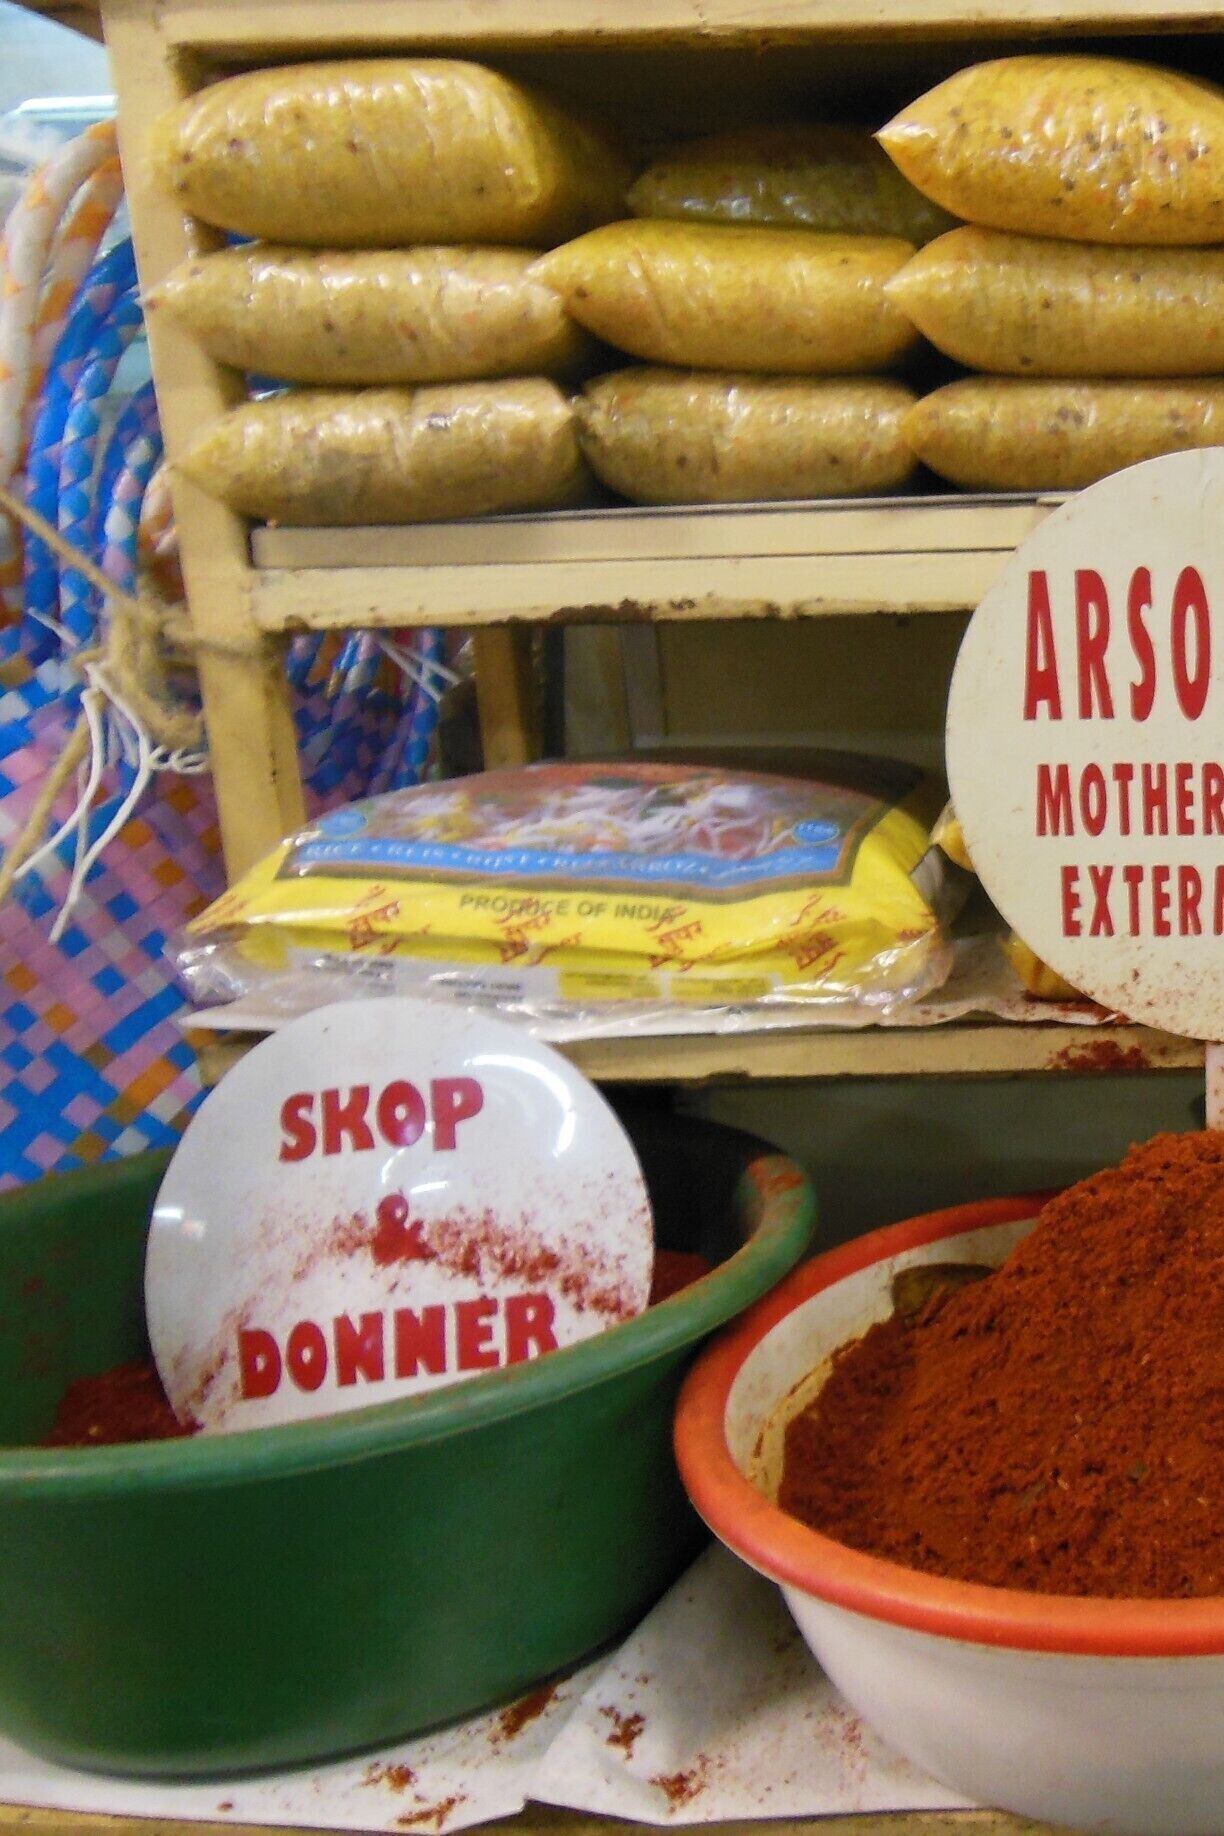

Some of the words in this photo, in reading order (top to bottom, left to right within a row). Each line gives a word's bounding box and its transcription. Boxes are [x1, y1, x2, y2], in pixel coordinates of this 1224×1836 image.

[459, 893, 570, 917] PRODUCE
[576, 899, 609, 918] OF
[614, 903, 677, 922] INDIA
[278, 1076, 485, 1164] SKOP
[371, 1193, 433, 1266] &
[237, 1293, 560, 1400] DONNER
